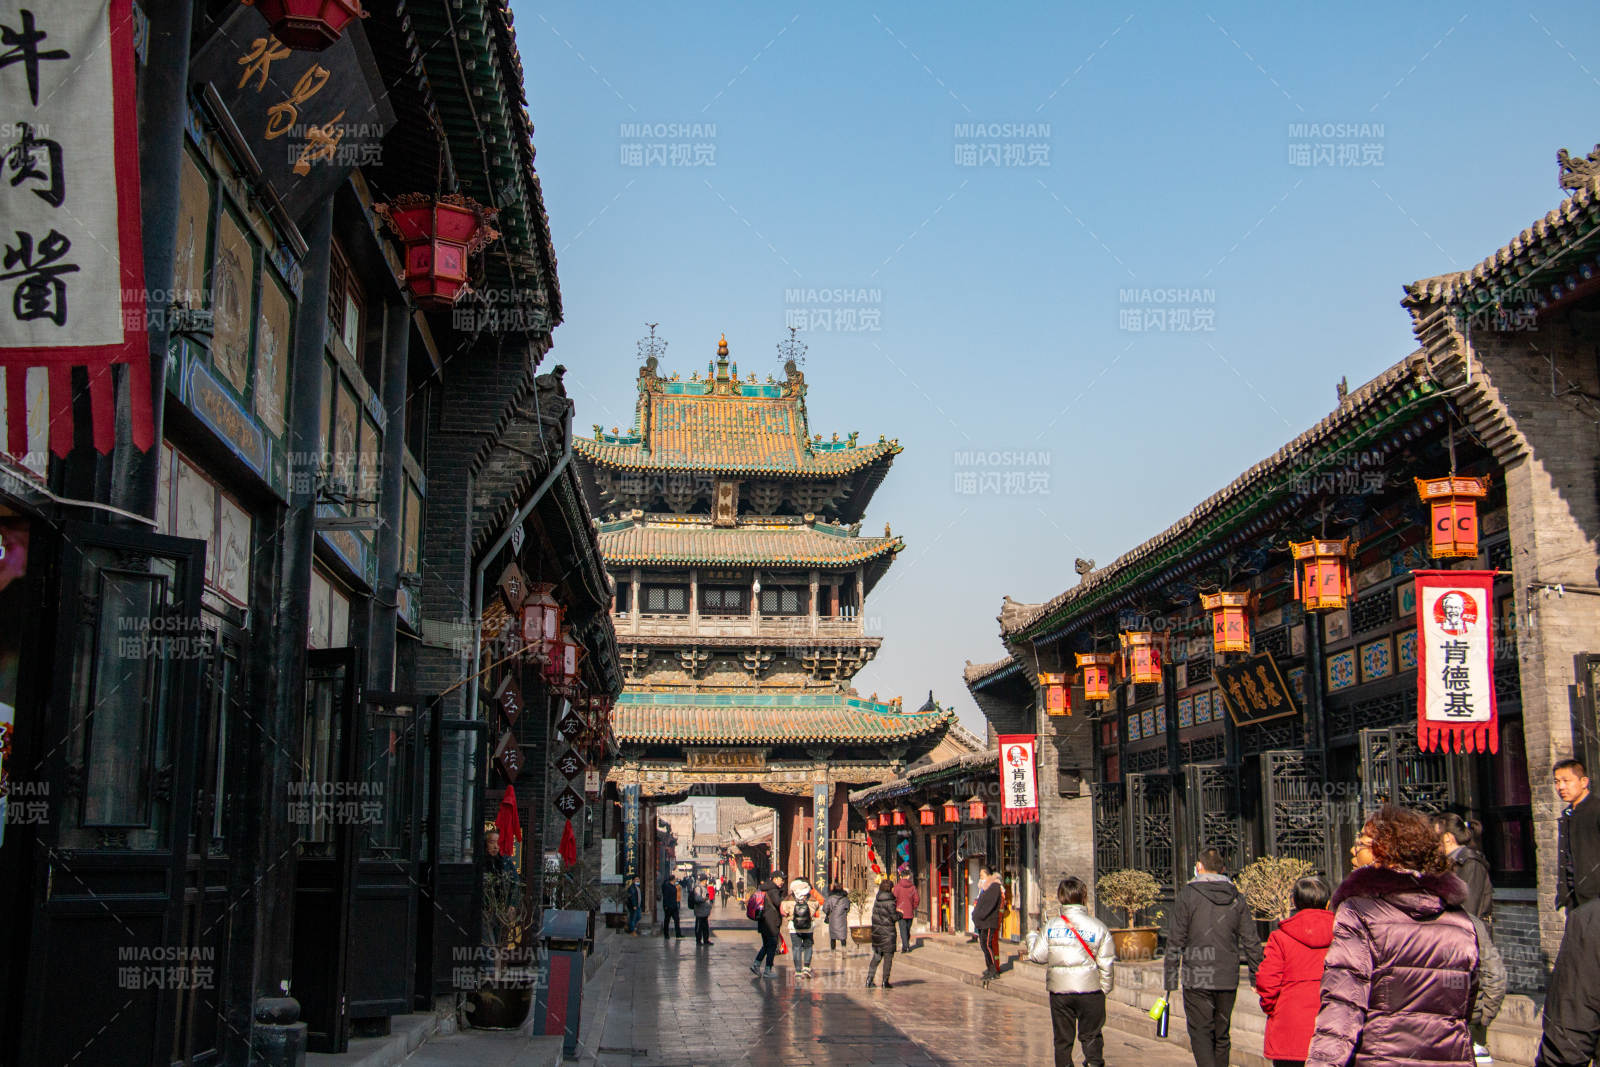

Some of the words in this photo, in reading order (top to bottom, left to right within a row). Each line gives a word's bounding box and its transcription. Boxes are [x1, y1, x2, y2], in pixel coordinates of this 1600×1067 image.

[1437, 517, 1450, 532] C
[1457, 516, 1472, 531] C
[1324, 573, 1336, 586] F
[1440, 639, 1475, 718] 肯德基
[1011, 768, 1028, 807] 肯德基
